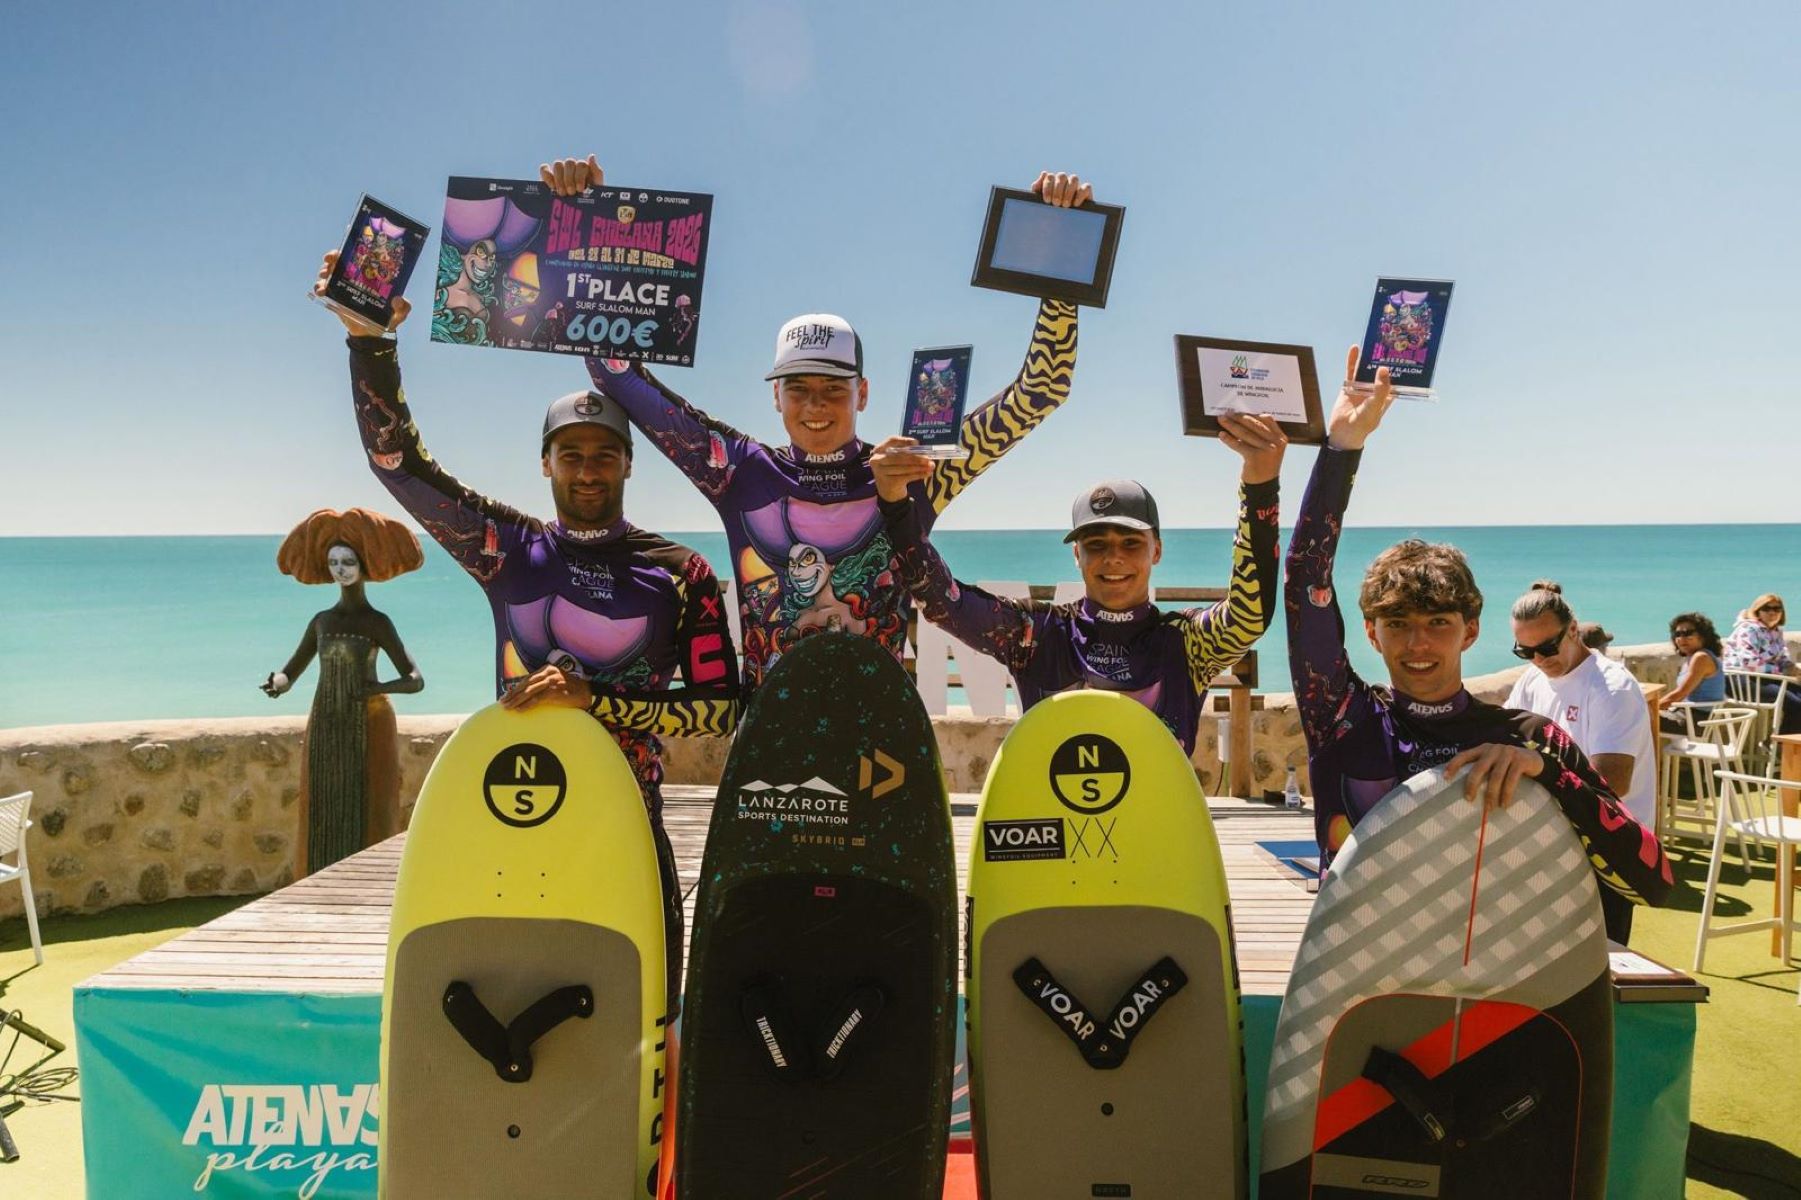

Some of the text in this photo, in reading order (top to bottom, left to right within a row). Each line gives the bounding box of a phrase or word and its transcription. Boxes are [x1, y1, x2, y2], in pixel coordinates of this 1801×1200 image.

[664, 196, 690, 205] DUOTONE
[588, 279, 671, 306] PLACE
[575, 300, 656, 316] SURF SLALOM MAN
[566, 314, 659, 348] 600€
[786, 324, 835, 342] FEEL THE
[825, 473, 847, 482] FOIL
[1086, 654, 1110, 665] WING
[515, 755, 536, 779] N
[1078, 745, 1099, 768] N
[1081, 778, 1101, 803] S
[514, 790, 534, 815] S
[738, 795, 848, 812] LANZAROTE
[738, 811, 849, 825] SPORTS DESTINATION
[792, 833, 845, 845] SKYBRID
[989, 827, 1058, 846] VOAR
[1040, 983, 1095, 1040] VOAR
[1109, 980, 1162, 1040] VOAR
[193, 1121, 379, 1200] playa
